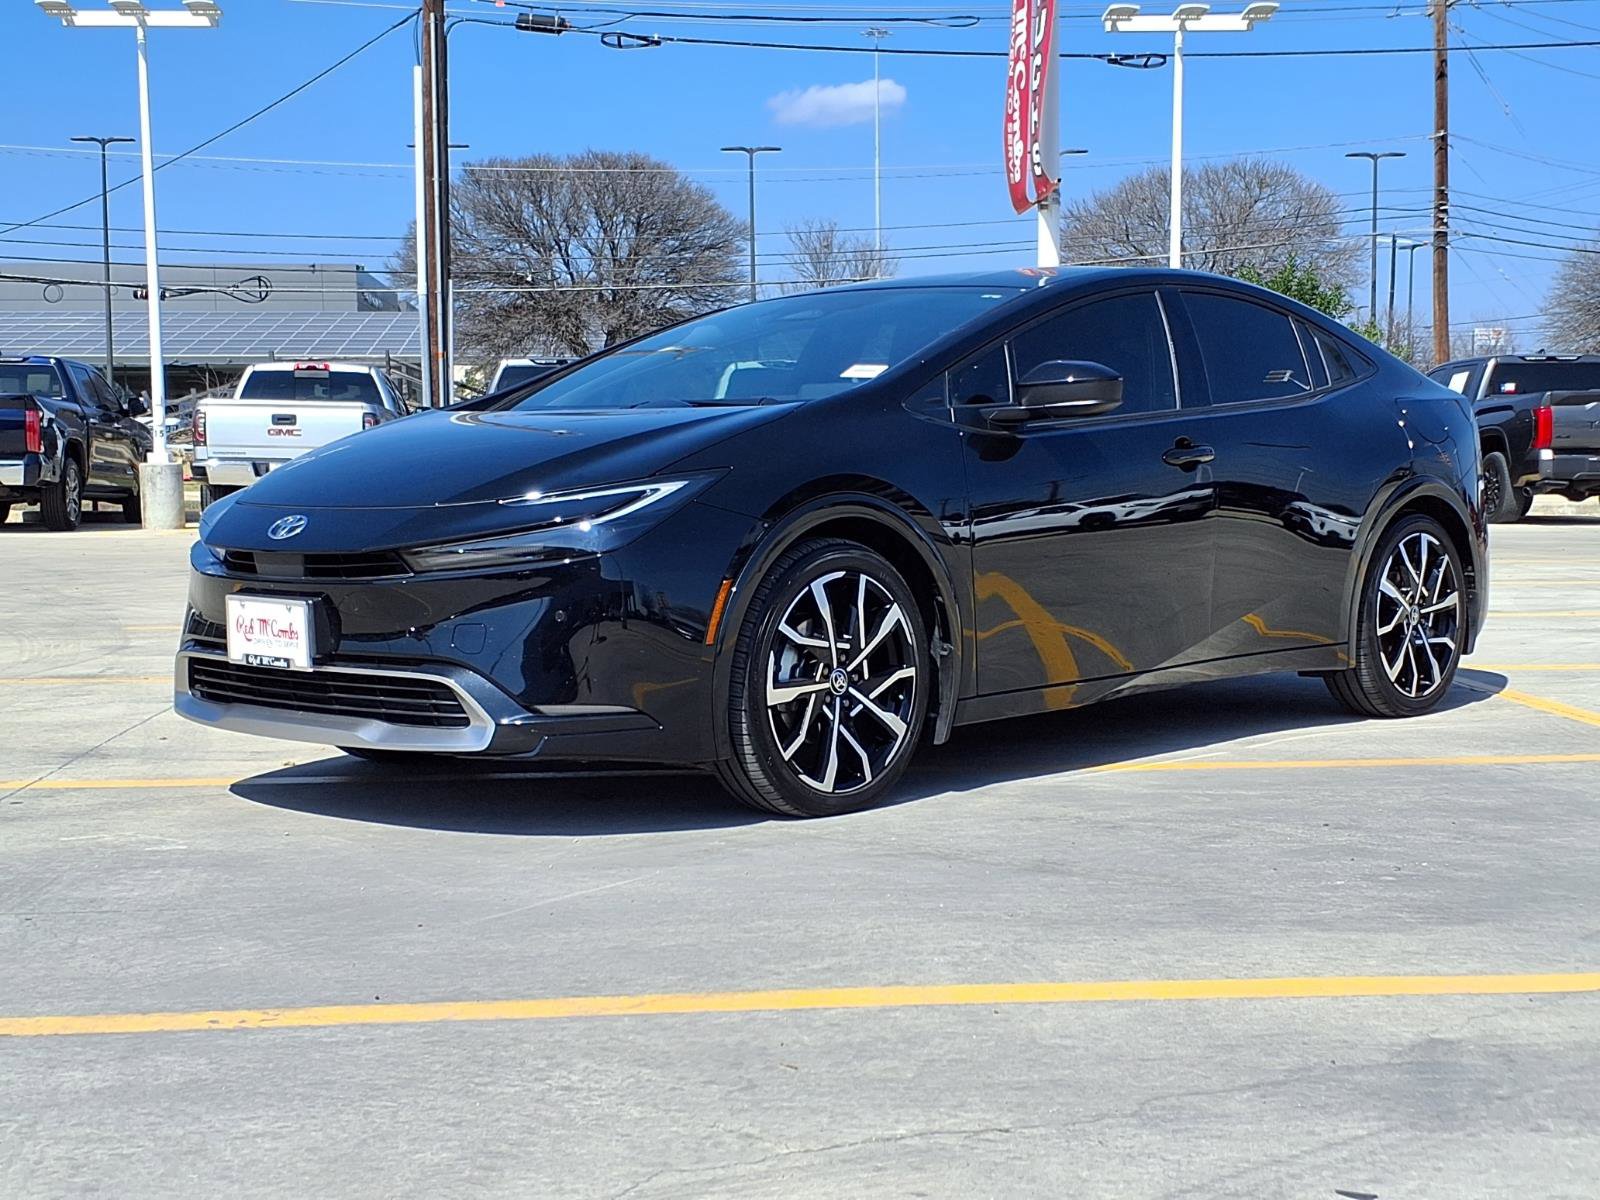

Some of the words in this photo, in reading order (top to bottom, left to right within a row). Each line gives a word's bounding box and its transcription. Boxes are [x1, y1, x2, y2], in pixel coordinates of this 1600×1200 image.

[267, 428, 302, 437] GMC
[236, 615, 254, 642] Red
[257, 618, 298, 640] McCombs
